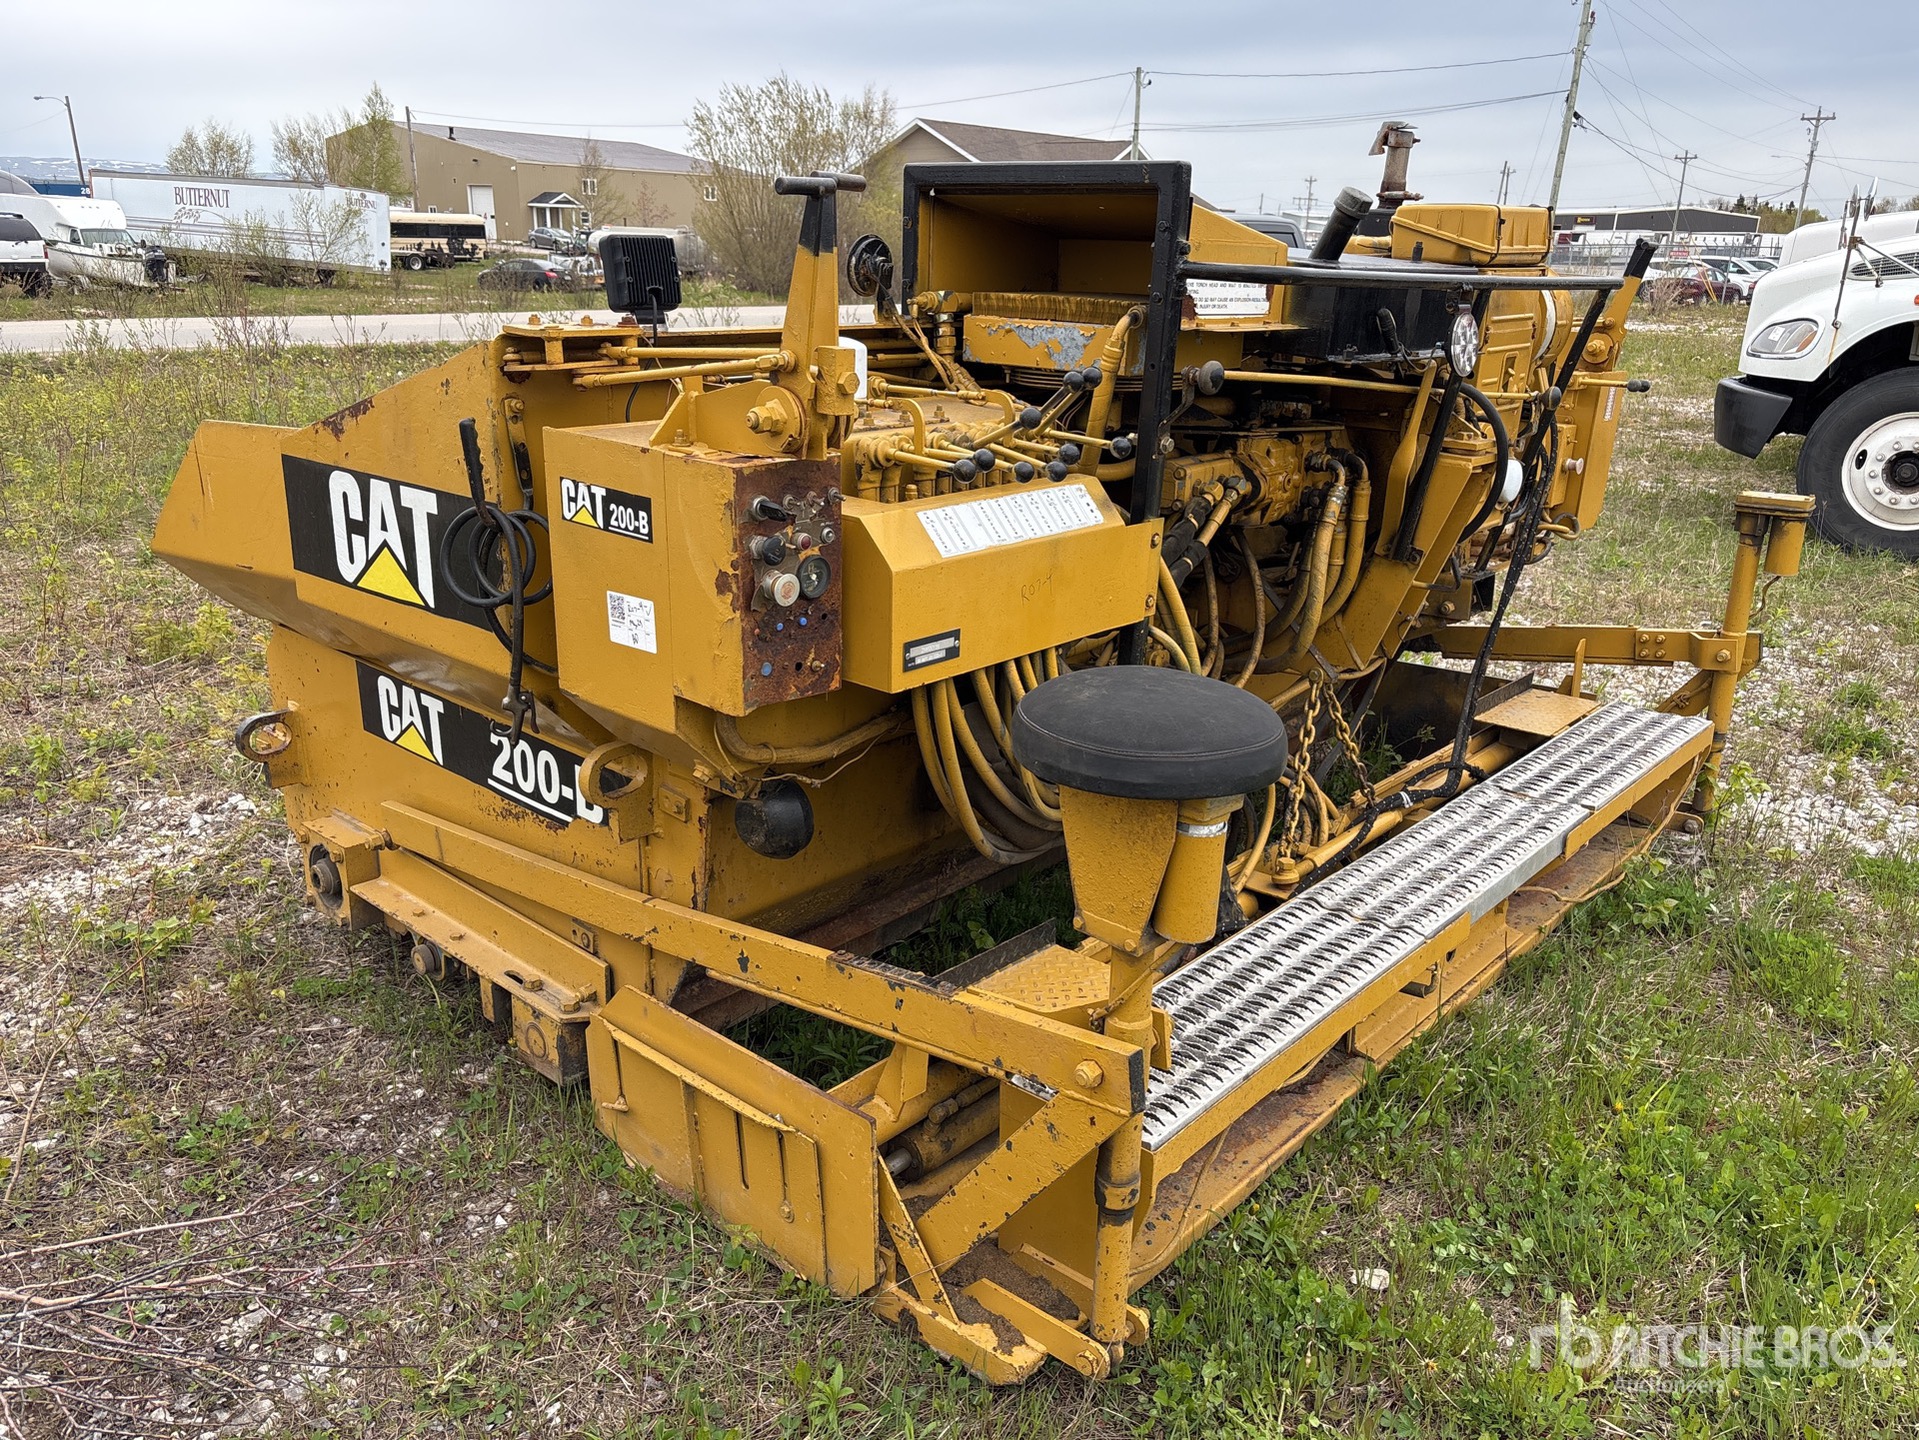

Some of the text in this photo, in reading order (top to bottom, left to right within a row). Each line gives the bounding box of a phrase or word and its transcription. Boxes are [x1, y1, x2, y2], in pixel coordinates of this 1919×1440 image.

[174, 186, 230, 208] BUTTERNUT
[328, 470, 438, 609] CAT
[561, 478, 650, 534] CAT 200-B
[377, 675, 444, 766] CAT
